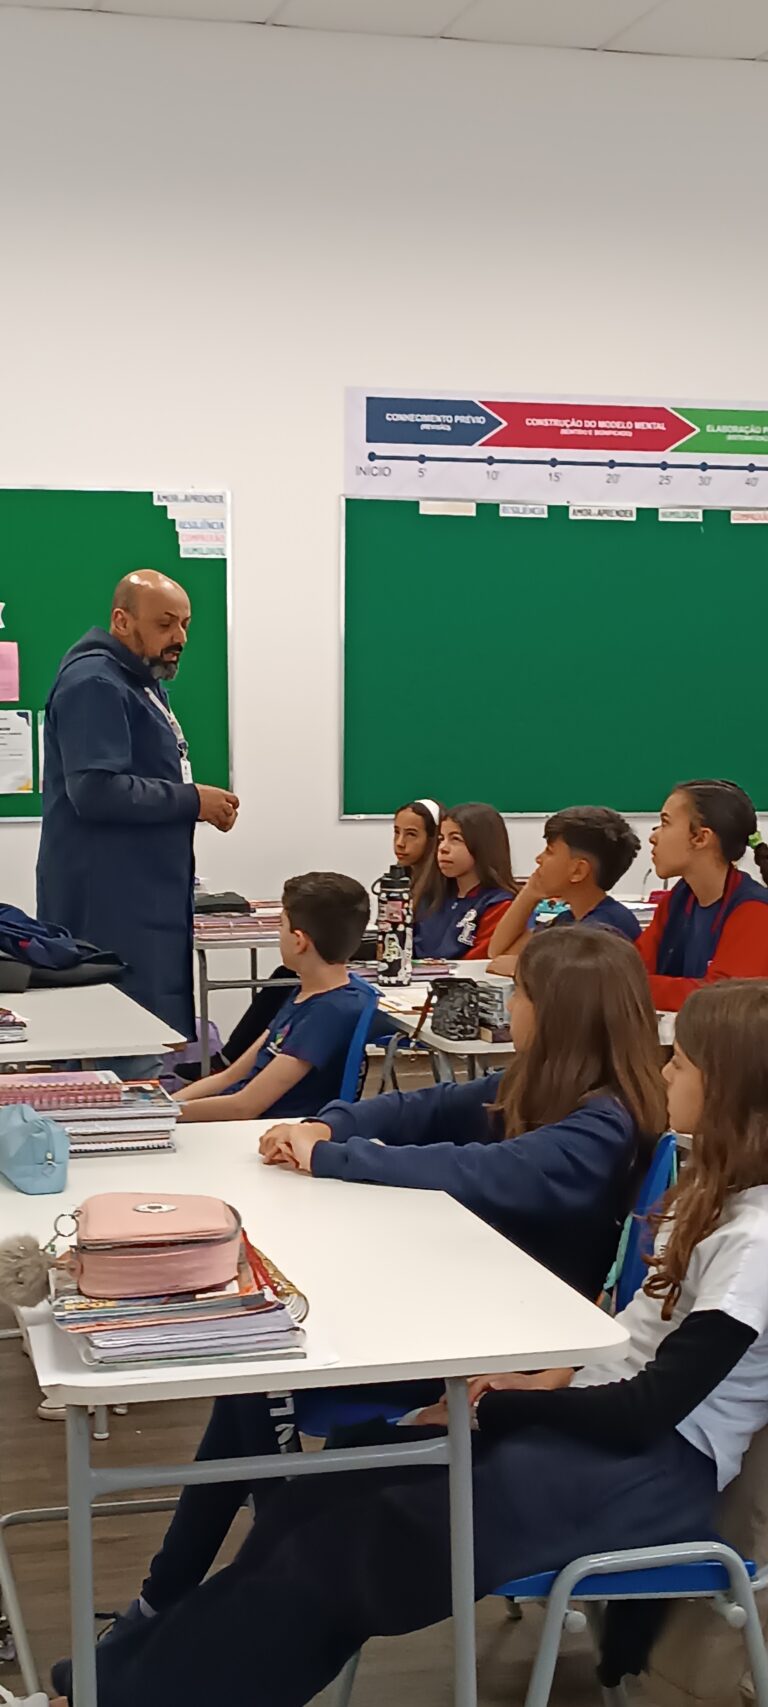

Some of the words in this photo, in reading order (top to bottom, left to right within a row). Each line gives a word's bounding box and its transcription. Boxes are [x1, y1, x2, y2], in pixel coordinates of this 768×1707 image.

[385, 413, 453, 423] CONHECIMENTO
[454, 413, 486, 424] PRÉVIO
[525, 418, 583, 429] CONSTRUÇÃO
[584, 419, 596, 428] DO
[598, 420, 633, 429] MODELO
[634, 421, 667, 430] MENTAL
[706, 424, 761, 434] ELABORAÇÃO
[355, 464, 392, 477] INÍCIO
